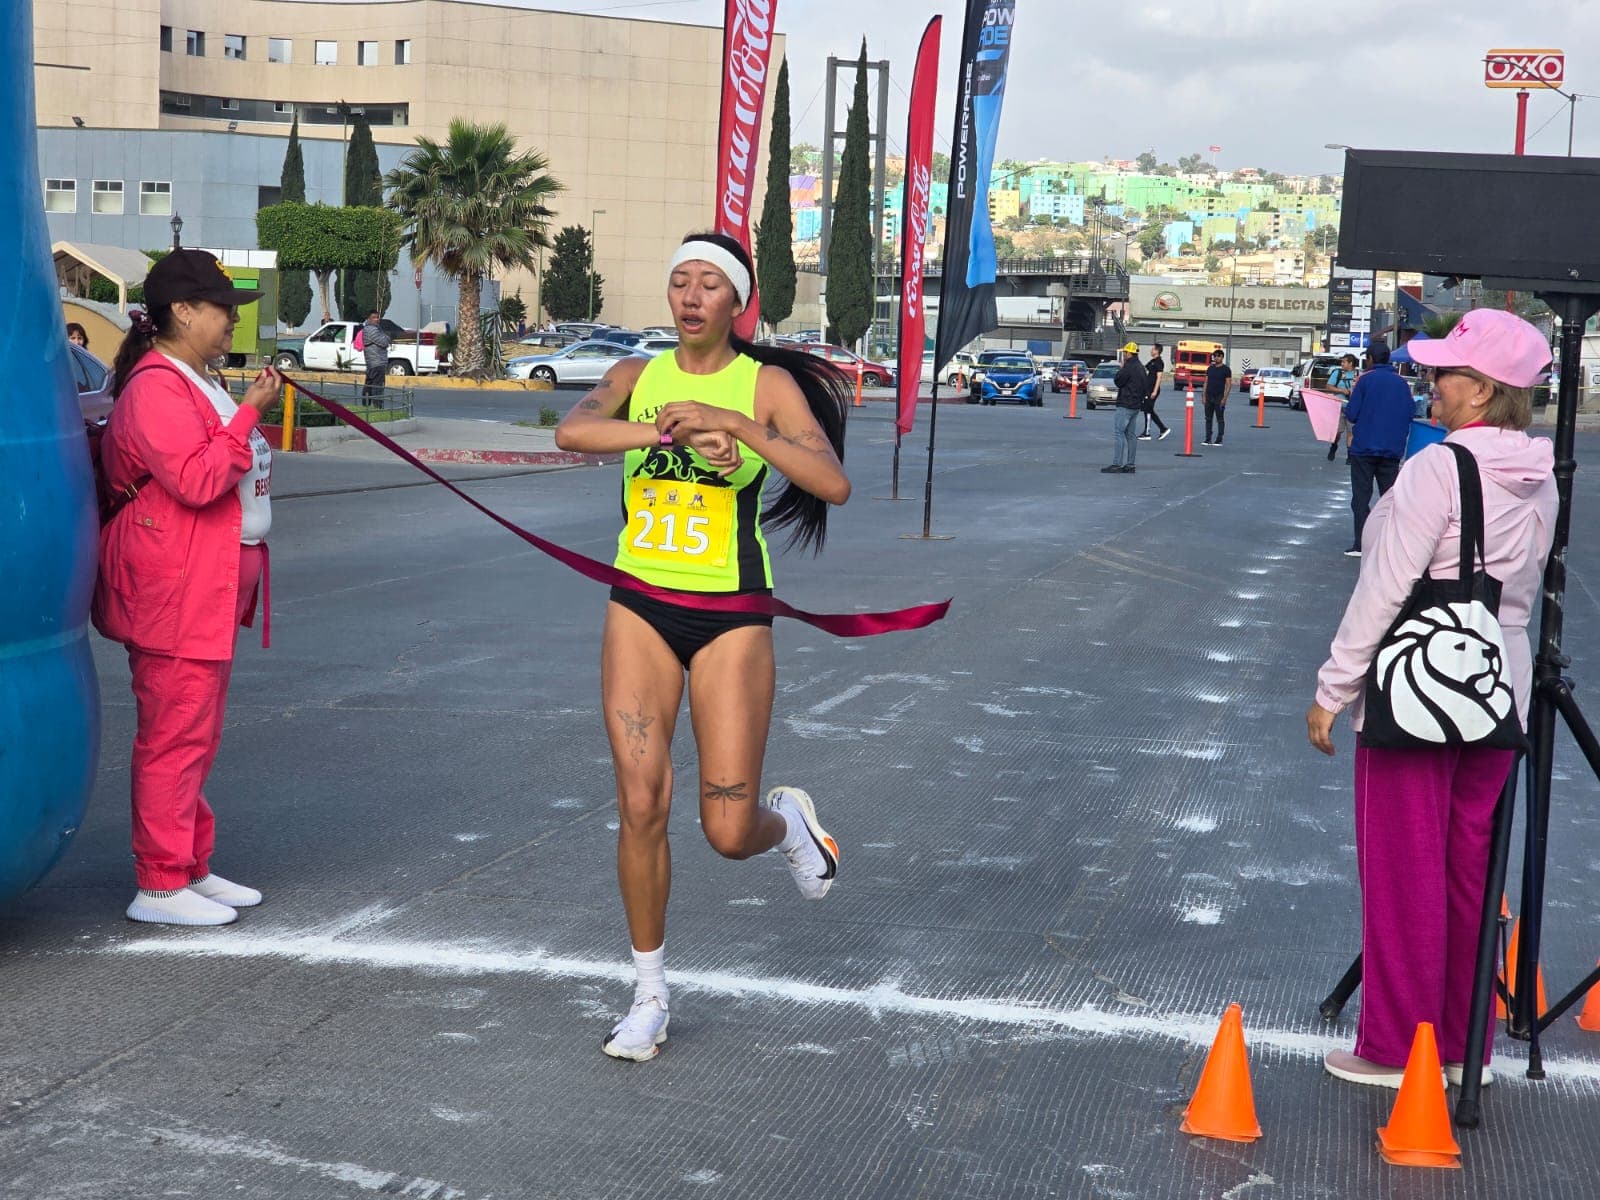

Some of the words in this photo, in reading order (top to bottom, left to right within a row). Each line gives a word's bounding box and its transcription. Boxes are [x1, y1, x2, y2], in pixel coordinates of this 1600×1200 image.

[1487, 54, 1562, 81] OXXO
[1204, 297, 1255, 309] FRUTAS
[1258, 298, 1325, 311] SELECTAS
[632, 510, 710, 555] 215
